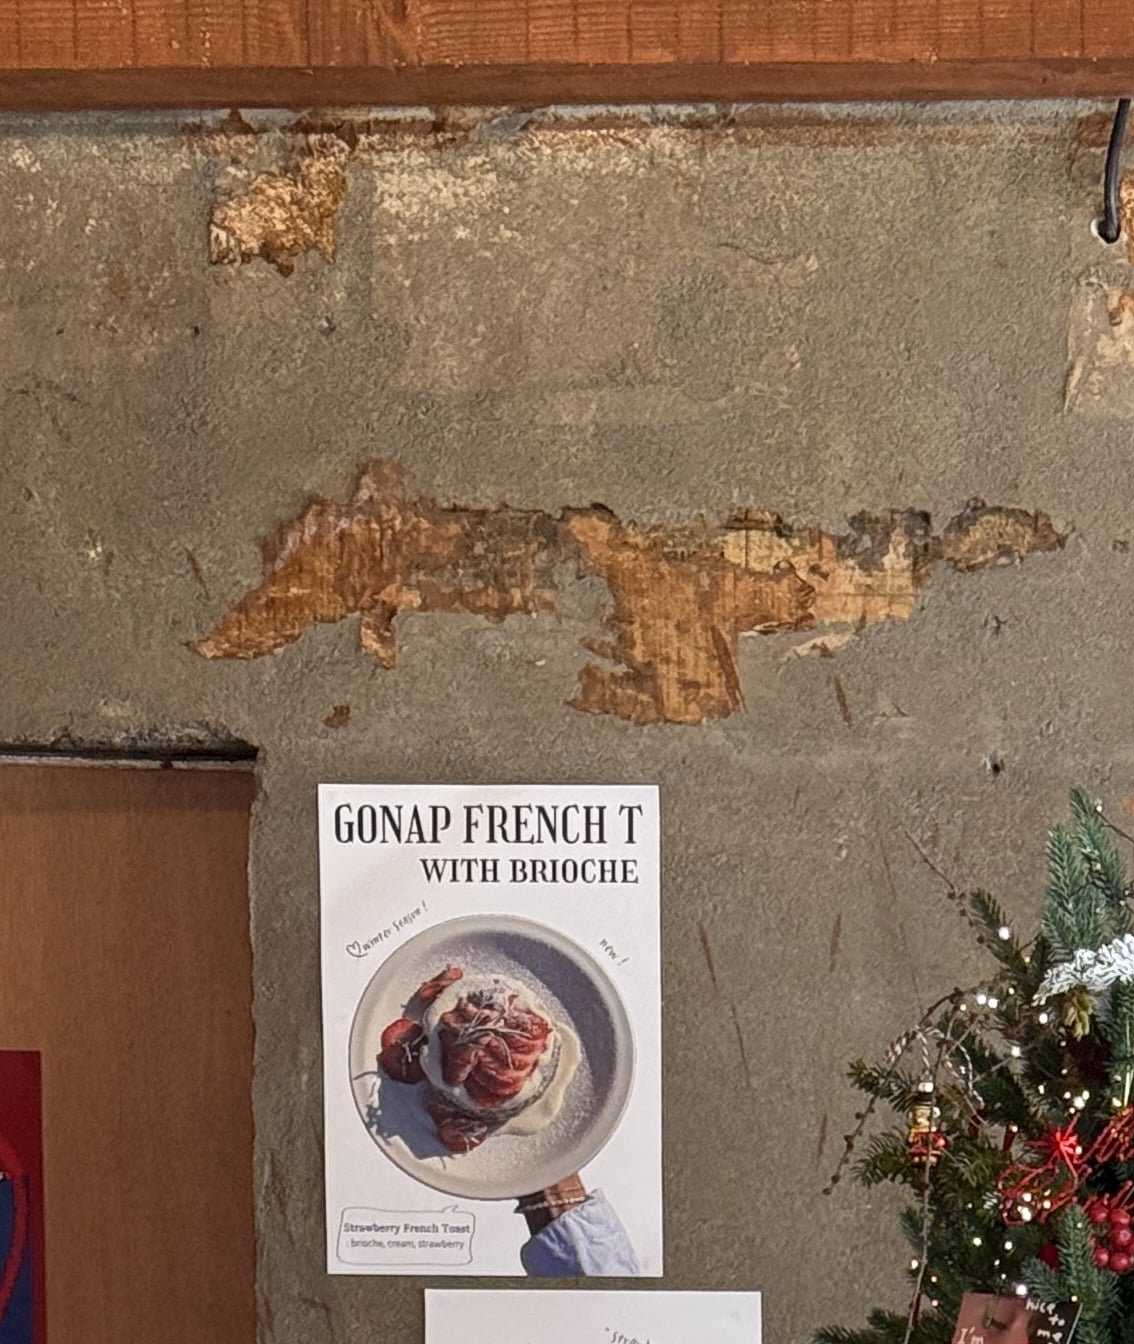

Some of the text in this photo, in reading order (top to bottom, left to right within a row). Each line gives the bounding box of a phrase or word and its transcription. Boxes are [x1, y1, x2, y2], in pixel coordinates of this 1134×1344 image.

[333, 803, 643, 845] GONAP FRENCH T
[419, 857, 639, 884] WITH BRIOCHE
[343, 1222, 471, 1235] Strawberry French Toast
[350, 1238, 464, 1250] brioche, cream, strawberry
[957, 1326, 984, 1344] I'm
